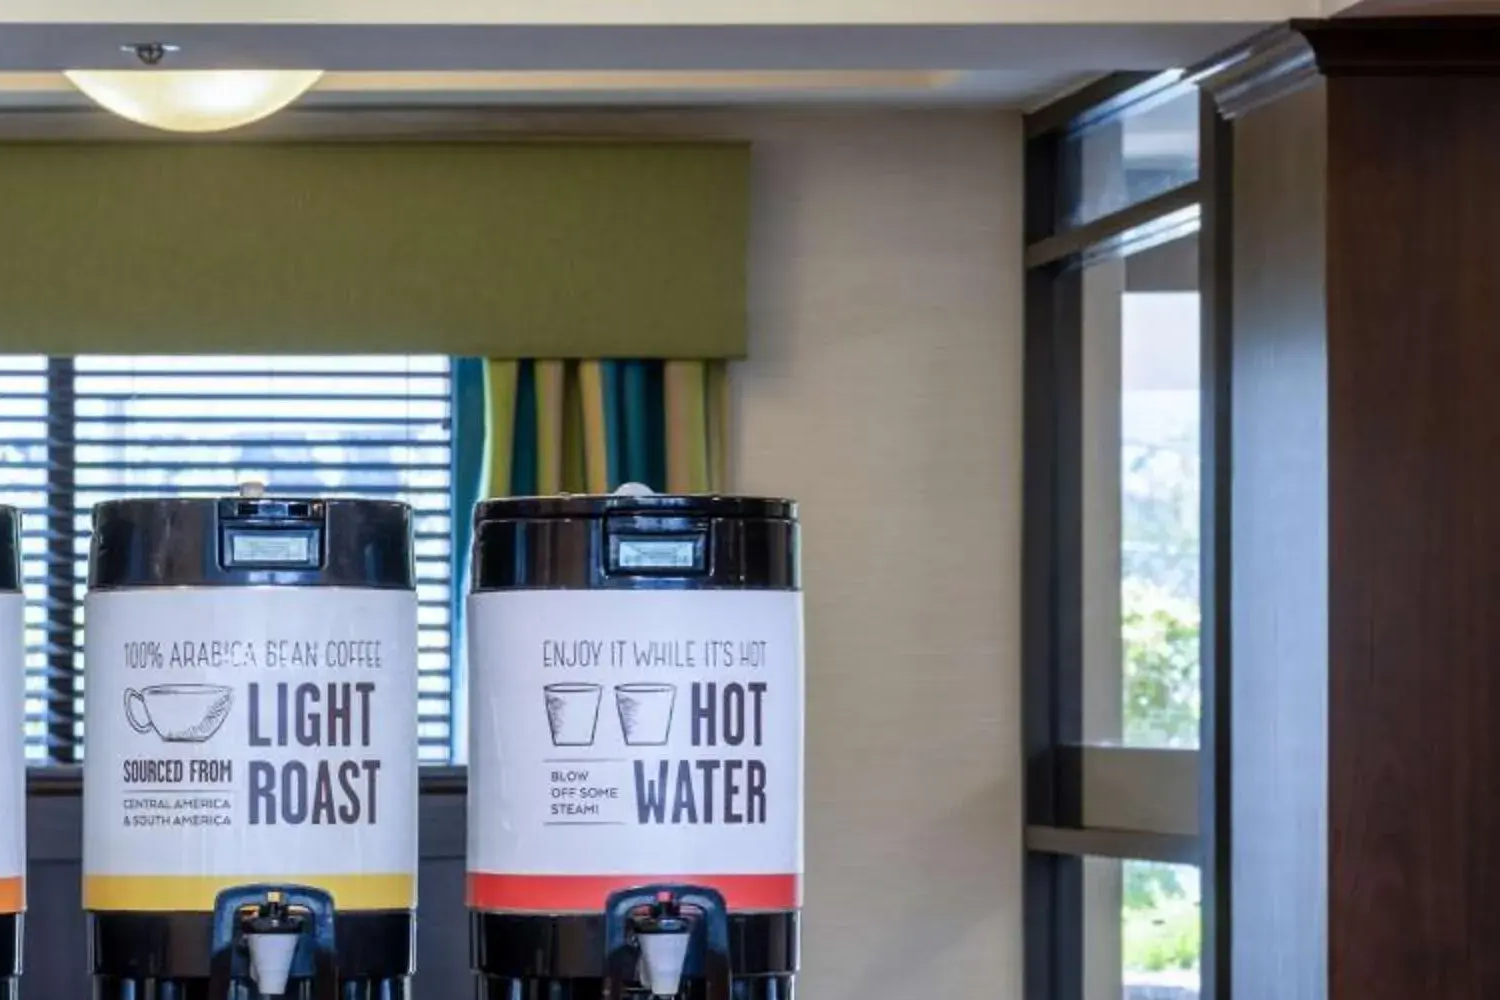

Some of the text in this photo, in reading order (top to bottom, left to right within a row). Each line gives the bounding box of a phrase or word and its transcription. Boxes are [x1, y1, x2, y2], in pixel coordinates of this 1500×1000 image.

[124, 640, 381, 669] 100% ARABICA BEAN COFFEE
[542, 640, 603, 668] ENJOY
[611, 640, 627, 668] IT
[633, 640, 696, 668] WHILE
[740, 640, 768, 668] HOT
[248, 682, 376, 747] LIGHT
[691, 682, 767, 746] HOT
[123, 759, 233, 783] SOURCED FROM
[551, 771, 590, 783] BLOW
[123, 799, 231, 810] CENTRAL AMERICA
[248, 759, 381, 825] ROAST
[551, 788, 618, 799] OFF SOME
[634, 759, 767, 825] WATER
[172, 815, 231, 826] AMERICA
[551, 804, 600, 815] STEAM!
